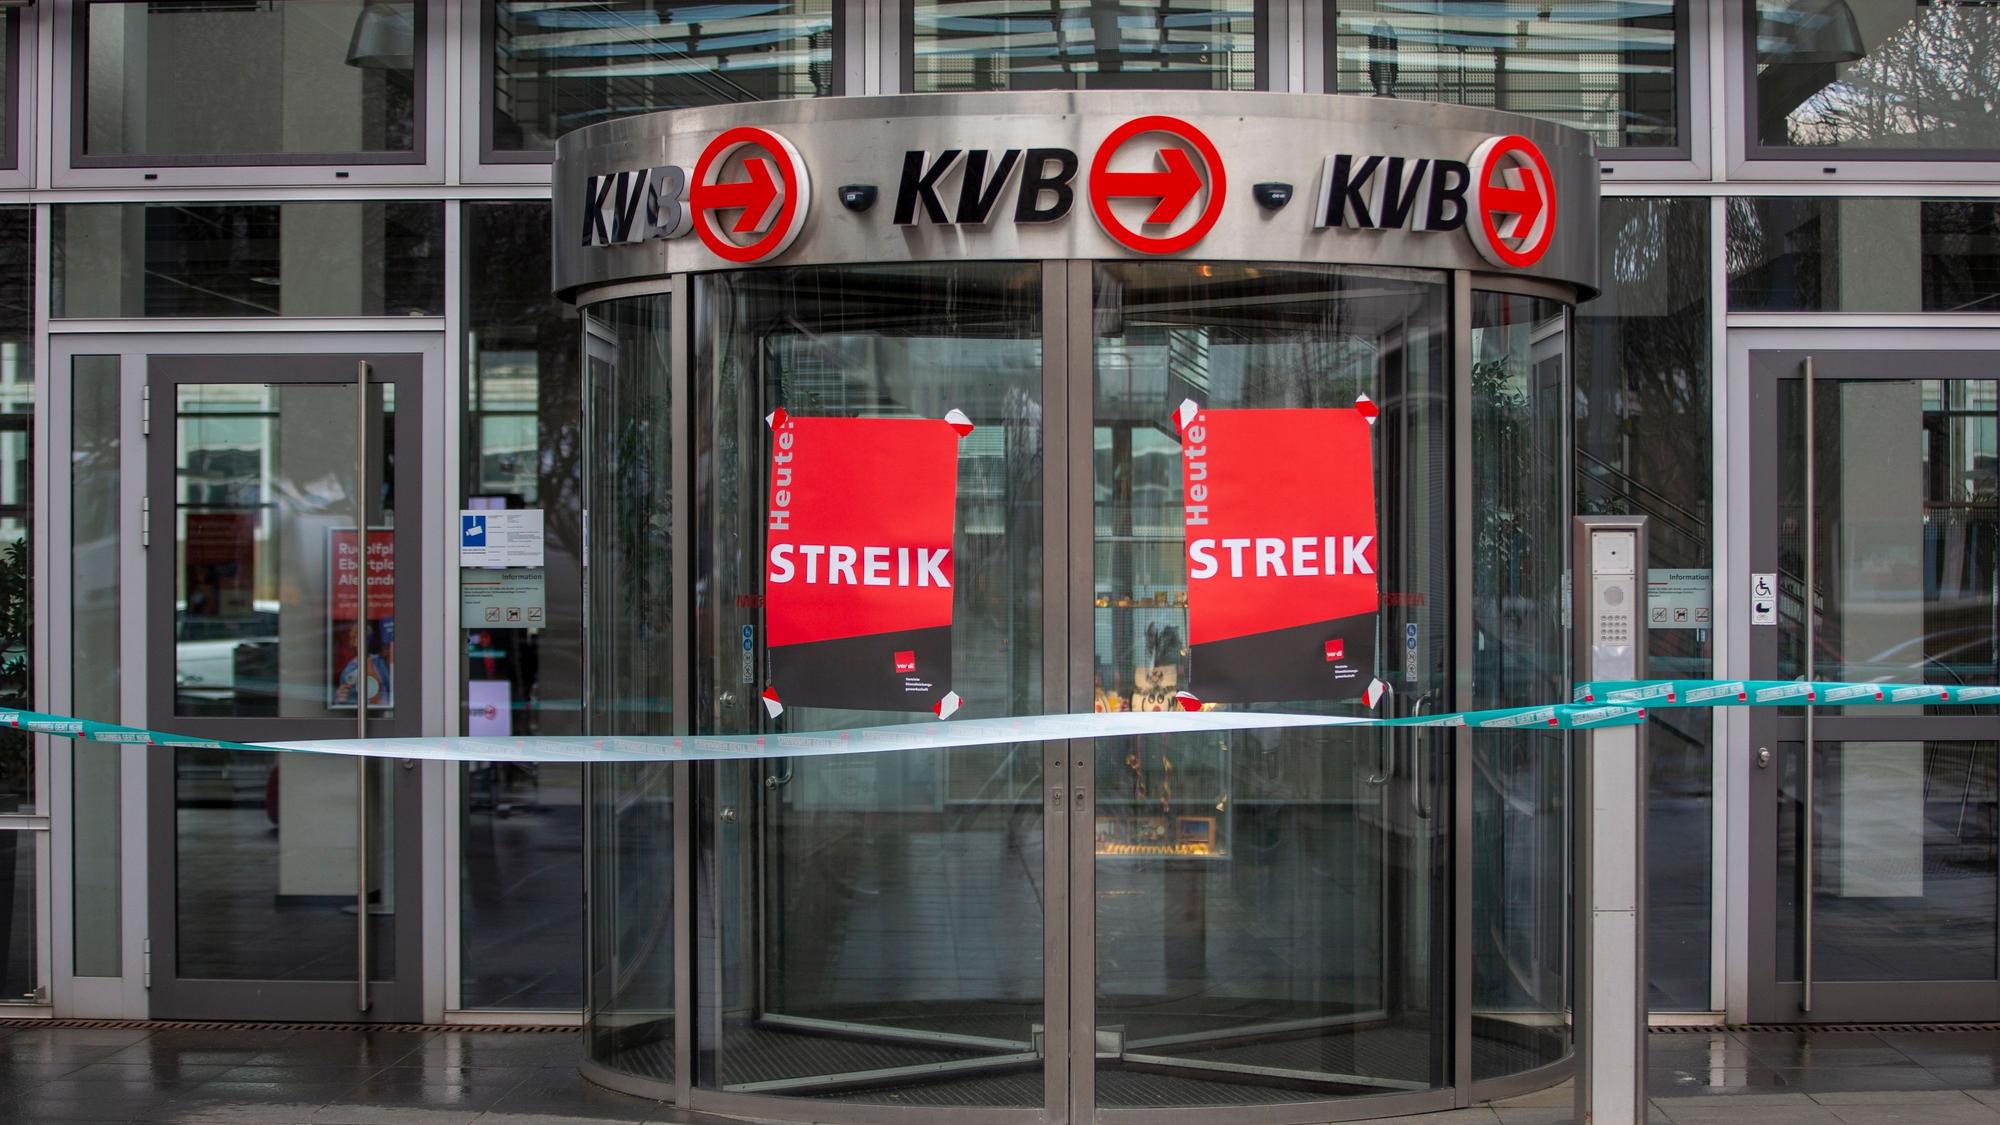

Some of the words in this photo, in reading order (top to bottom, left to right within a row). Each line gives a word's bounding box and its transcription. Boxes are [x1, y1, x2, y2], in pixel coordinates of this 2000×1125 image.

[582, 165, 688, 247] KVB
[893, 148, 1079, 225] KVB
[1316, 154, 1471, 231] KVB
[769, 543, 952, 588] STREIK
[1189, 535, 1375, 579] STREIK
